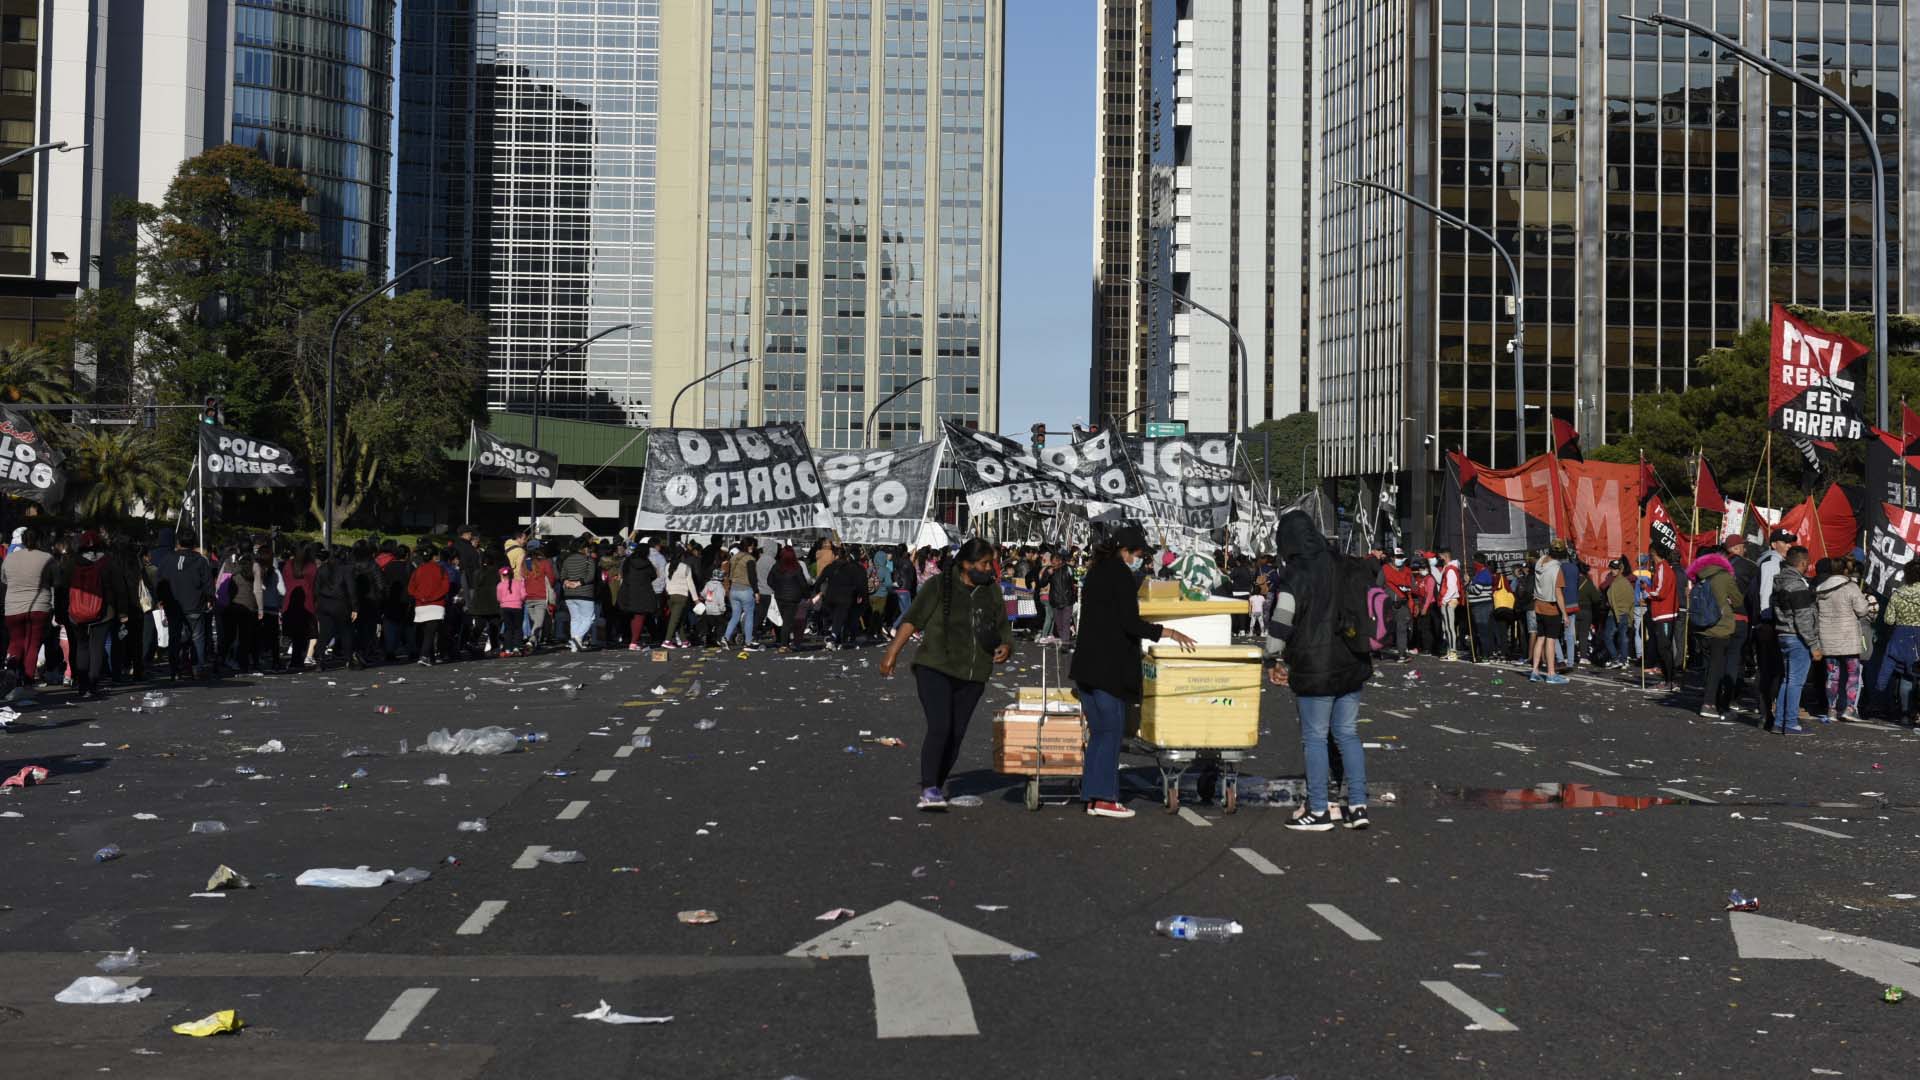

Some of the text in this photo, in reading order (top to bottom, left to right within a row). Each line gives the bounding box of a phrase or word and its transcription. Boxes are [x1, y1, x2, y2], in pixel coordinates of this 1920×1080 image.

[1783, 321, 1855, 391] MTL
[1783, 408, 1861, 440] PARERA
[219, 437, 280, 460] POLO
[491, 442, 540, 464] POLO
[208, 454, 295, 475] OBRERO
[480, 452, 551, 478] OBRERO
